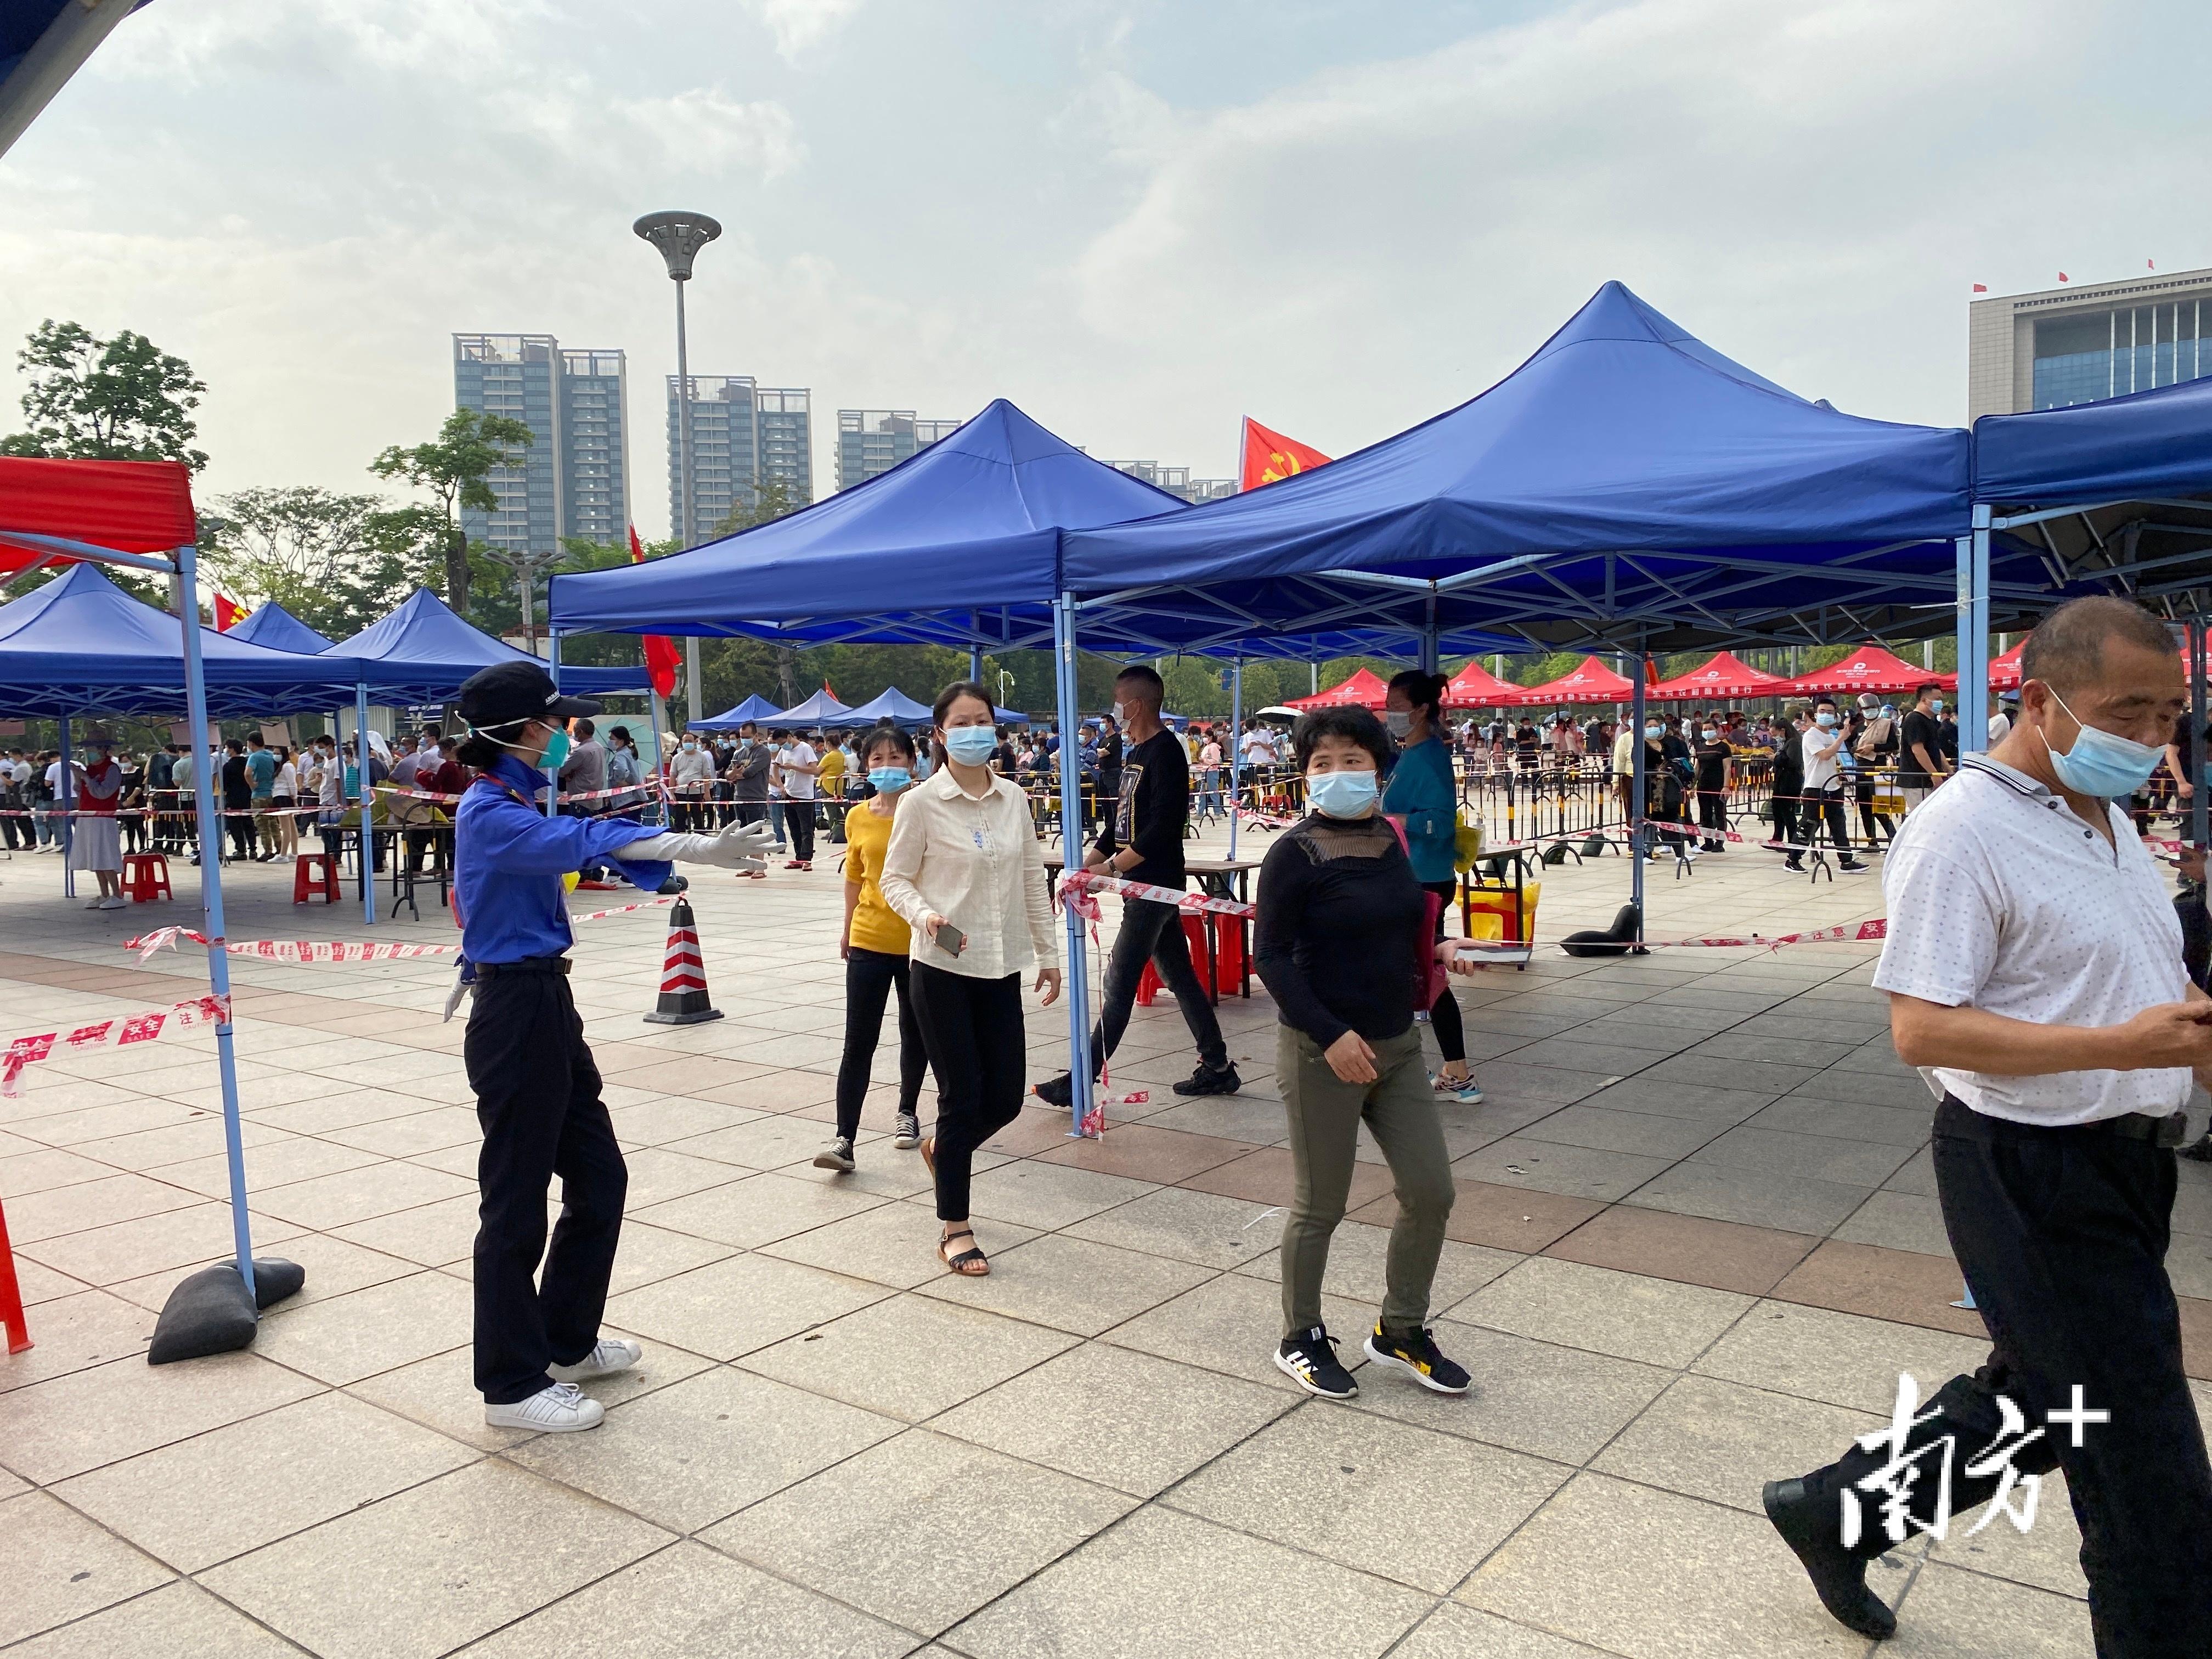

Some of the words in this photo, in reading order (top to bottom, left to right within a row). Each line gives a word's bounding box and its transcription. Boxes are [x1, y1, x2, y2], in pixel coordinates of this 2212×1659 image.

[1653, 685, 1752, 697] 东莞农村商业银行
[1126, 885, 1144, 896] 安全
[1153, 891, 1175, 901] 注意
[1184, 897, 1204, 907] 安全
[1213, 902, 1236, 912] 注意
[1813, 927, 1846, 940] 注意
[127, 1018, 159, 1036] 安全
[179, 1008, 213, 1025] 注意
[74, 1042, 107, 1052] CAUTION
[127, 1034, 151, 1042] SAFE
[183, 1020, 212, 1030] CAUTION
